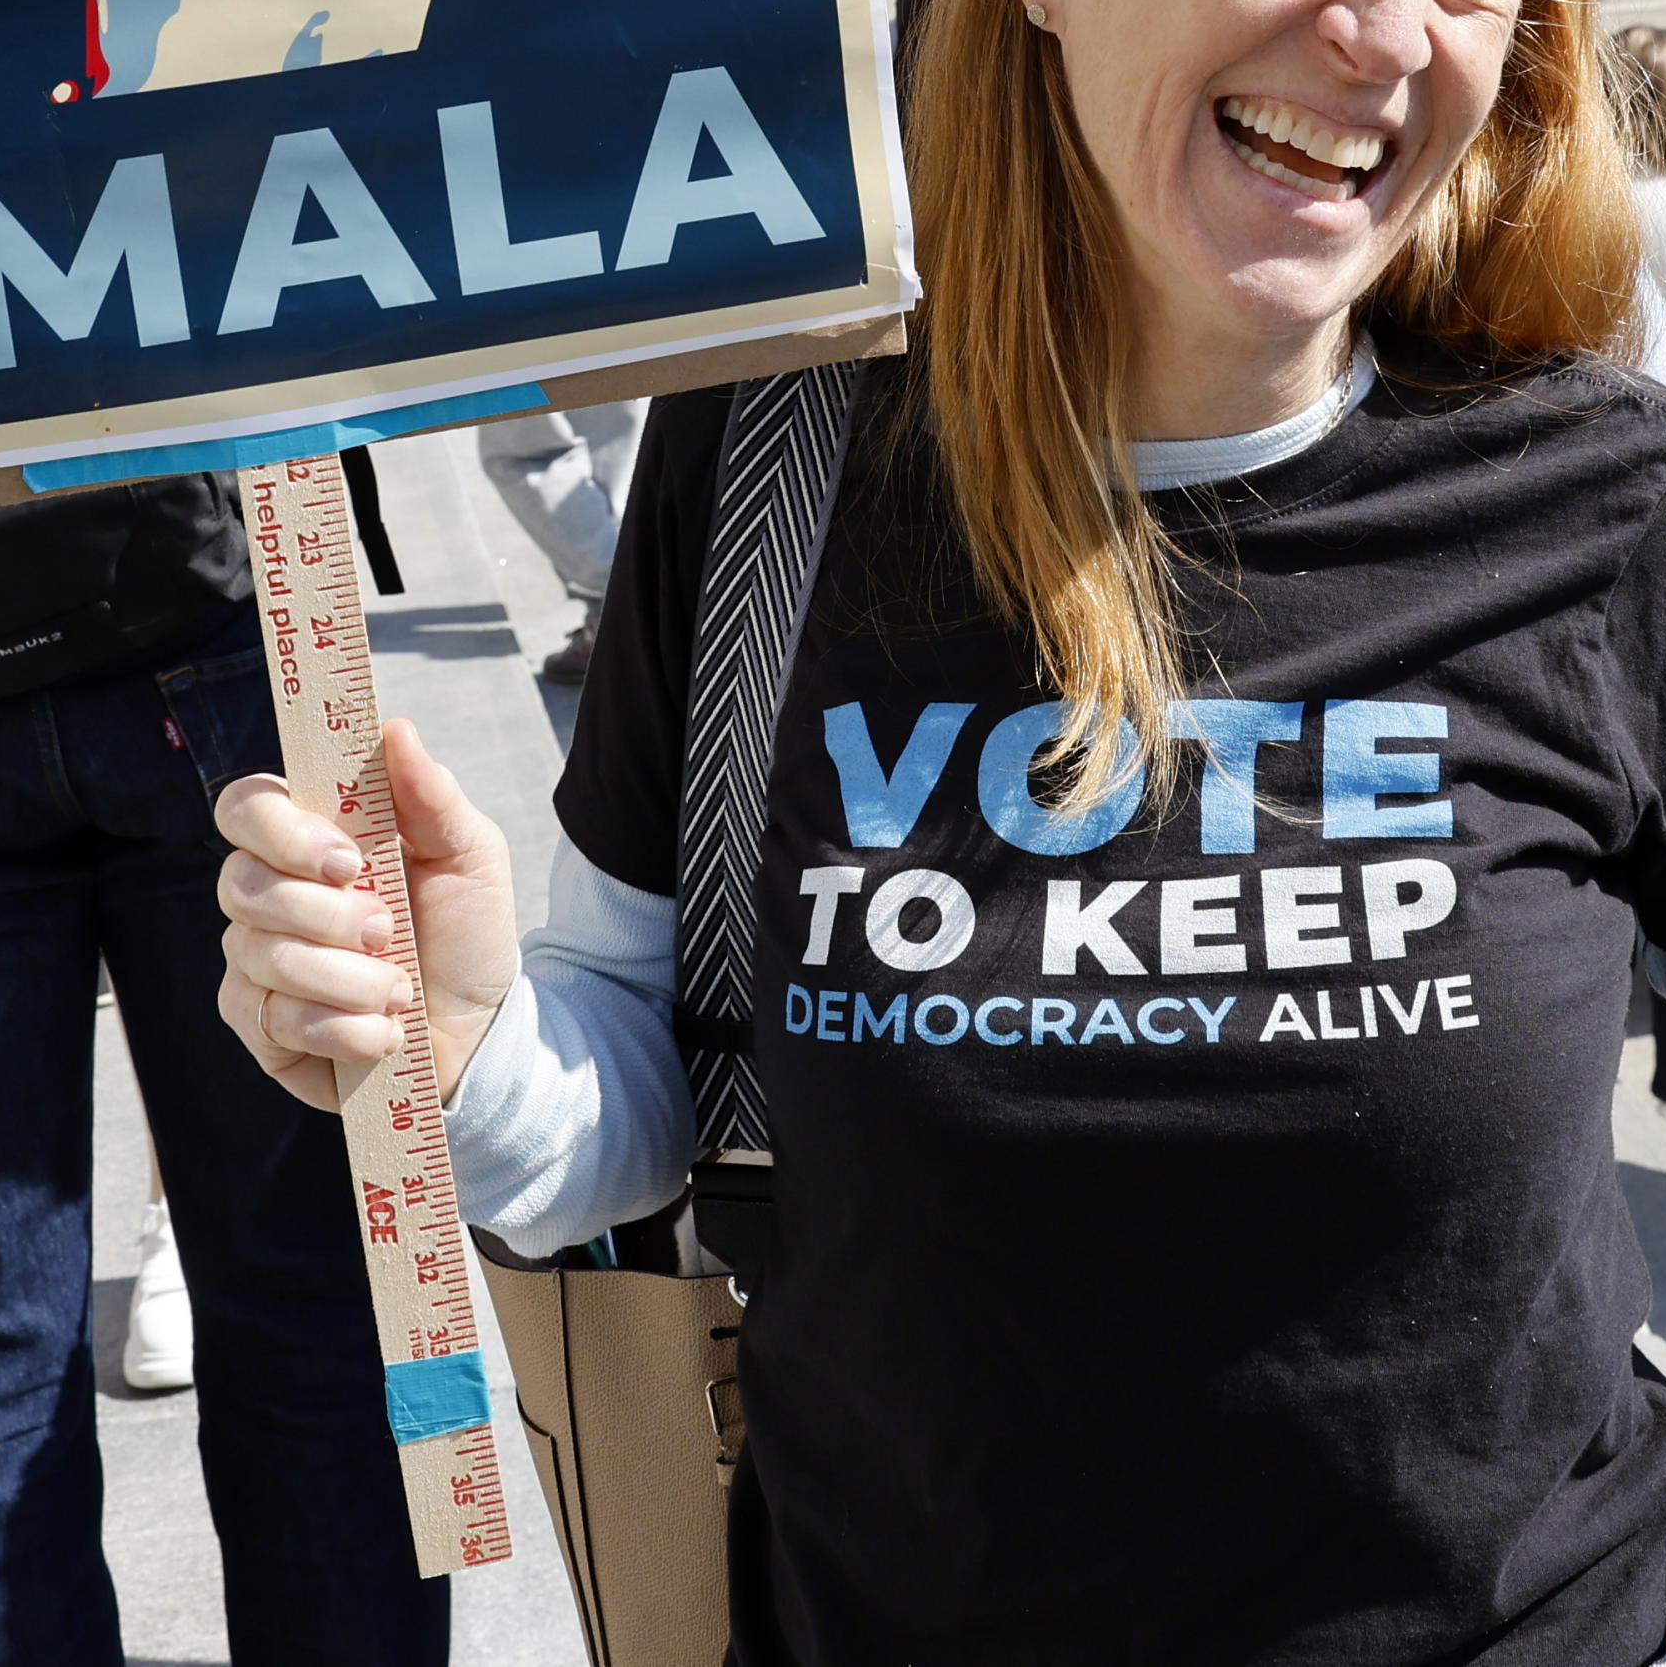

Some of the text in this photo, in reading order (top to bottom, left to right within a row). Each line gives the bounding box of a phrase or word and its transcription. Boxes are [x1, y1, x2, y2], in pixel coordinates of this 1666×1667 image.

[297, 531, 324, 567] 23
[254, 481, 301, 705] helpful place.
[310, 616, 337, 650] 24
[323, 698, 350, 732] 25
[823, 695, 1455, 854] VOTE
[337, 779, 363, 814] 26
[800, 857, 1459, 975] TO KEEP
[784, 973, 1480, 1047] DEMOCRACY ALIVE
[388, 1097, 414, 1131] 30
[401, 1174, 427, 1209] 31
[362, 1180, 399, 1245] ACE
[414, 1251, 440, 1285] 32
[426, 1326, 451, 1357] 33
[450, 1473, 476, 1506] 35
[460, 1534, 485, 1561] 36
